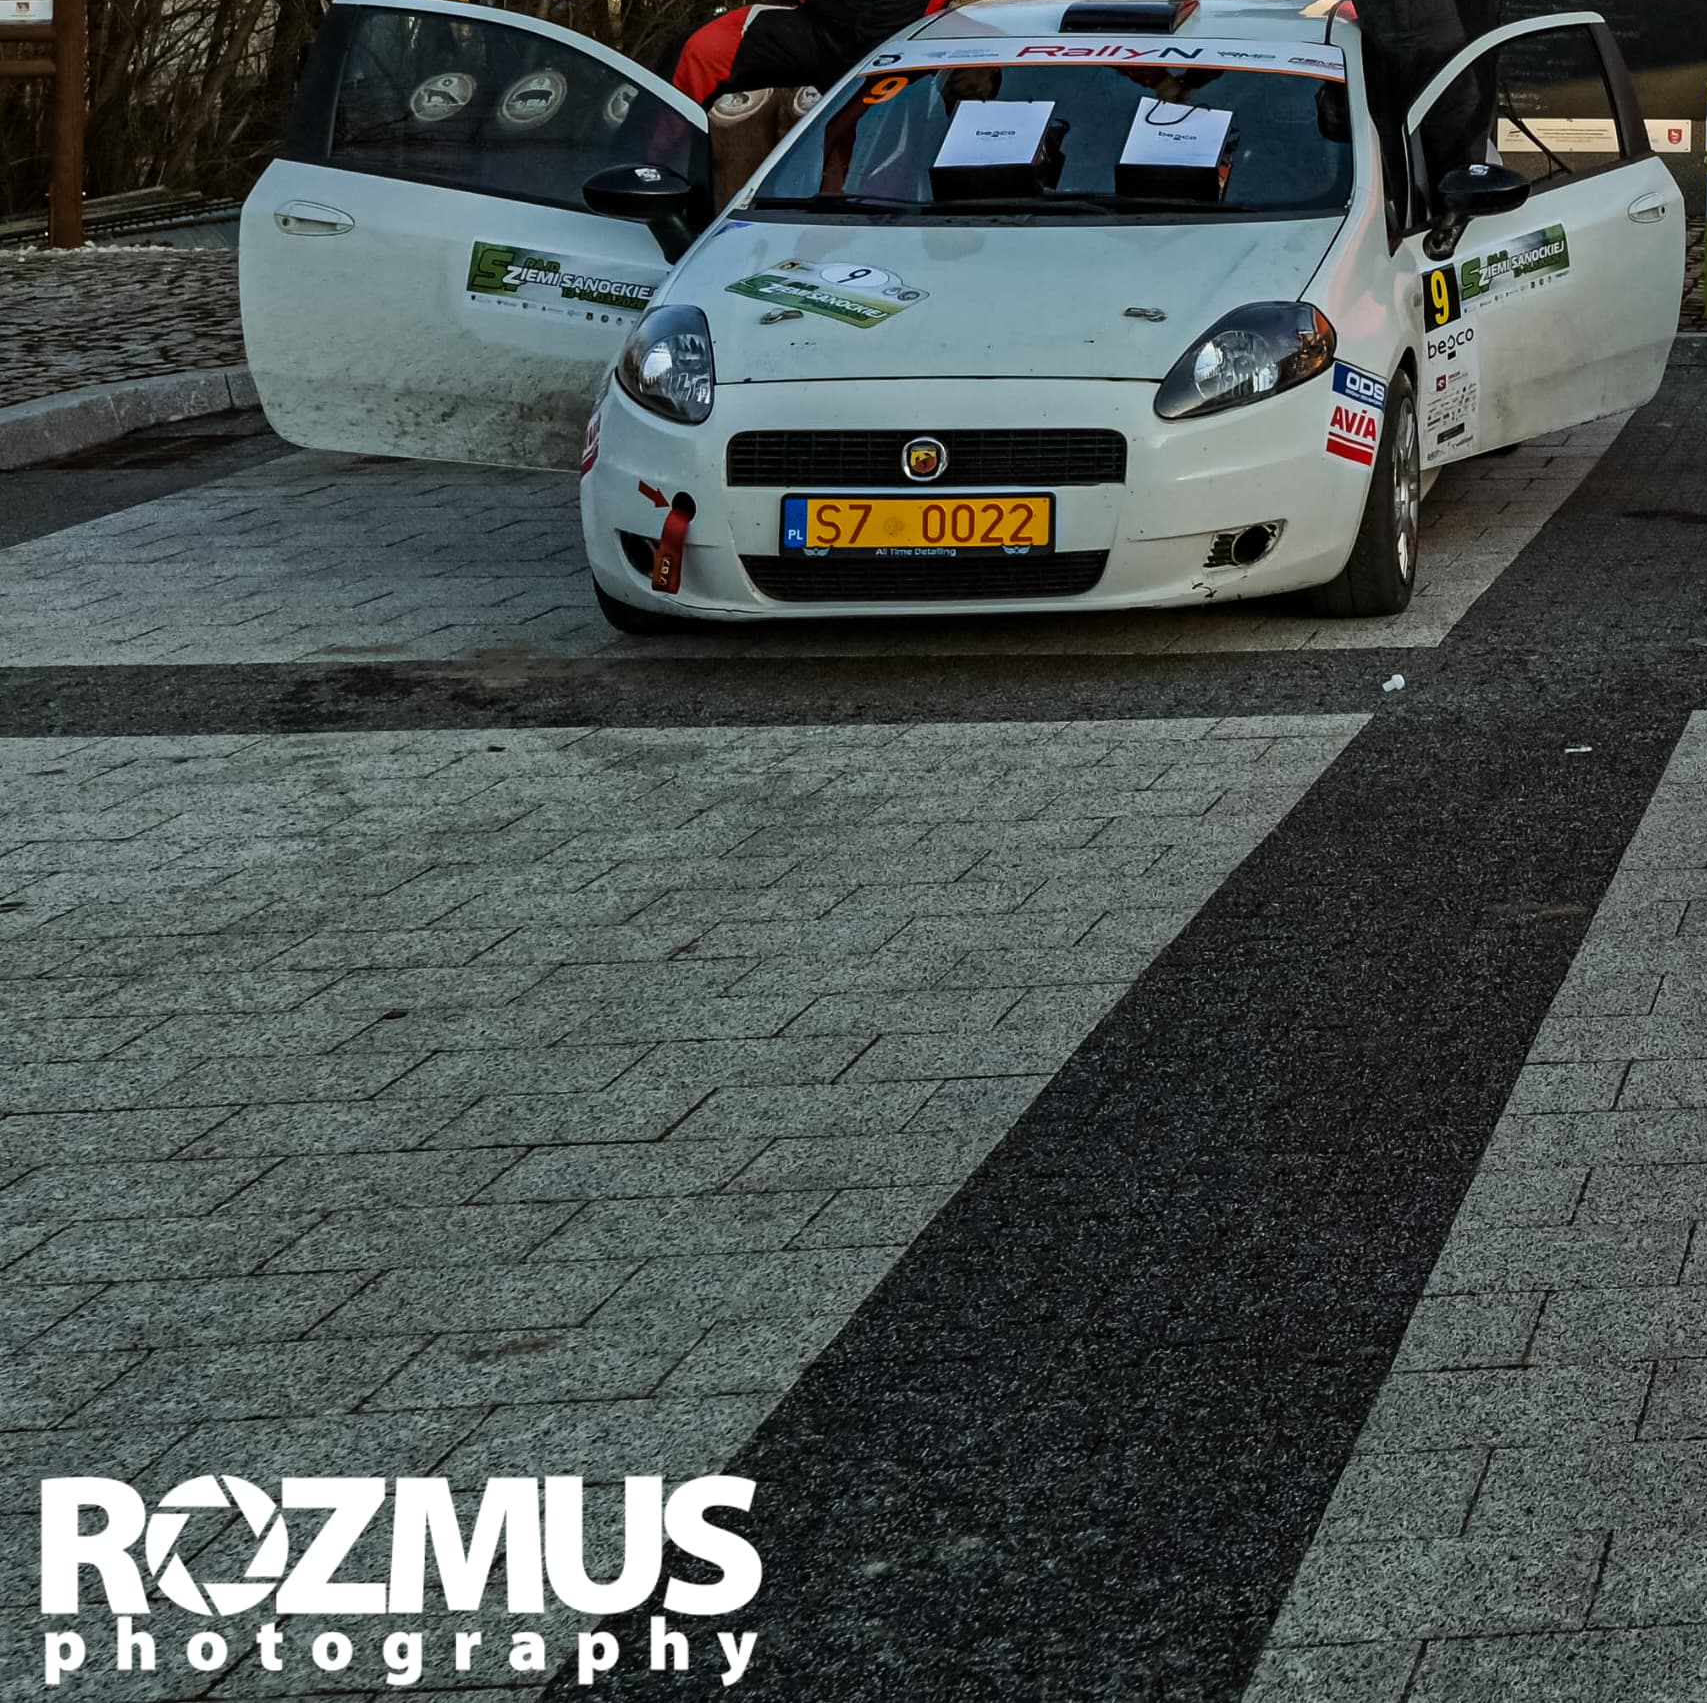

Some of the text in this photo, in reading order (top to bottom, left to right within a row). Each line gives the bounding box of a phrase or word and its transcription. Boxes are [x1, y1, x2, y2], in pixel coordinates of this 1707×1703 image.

[863, 76, 910, 105] 9
[502, 265, 561, 287] ZIEMI
[837, 268, 873, 284] 9
[1478, 259, 1512, 286] ZIEMI
[1510, 241, 1565, 270] SANOCKIEJ
[1430, 270, 1449, 326] 9
[1346, 372, 1385, 402] ODS
[788, 530, 803, 541] PL
[816, 503, 1034, 544] S7 0022
[890, 547, 912, 557] Time
[914, 547, 957, 558] Detailing
